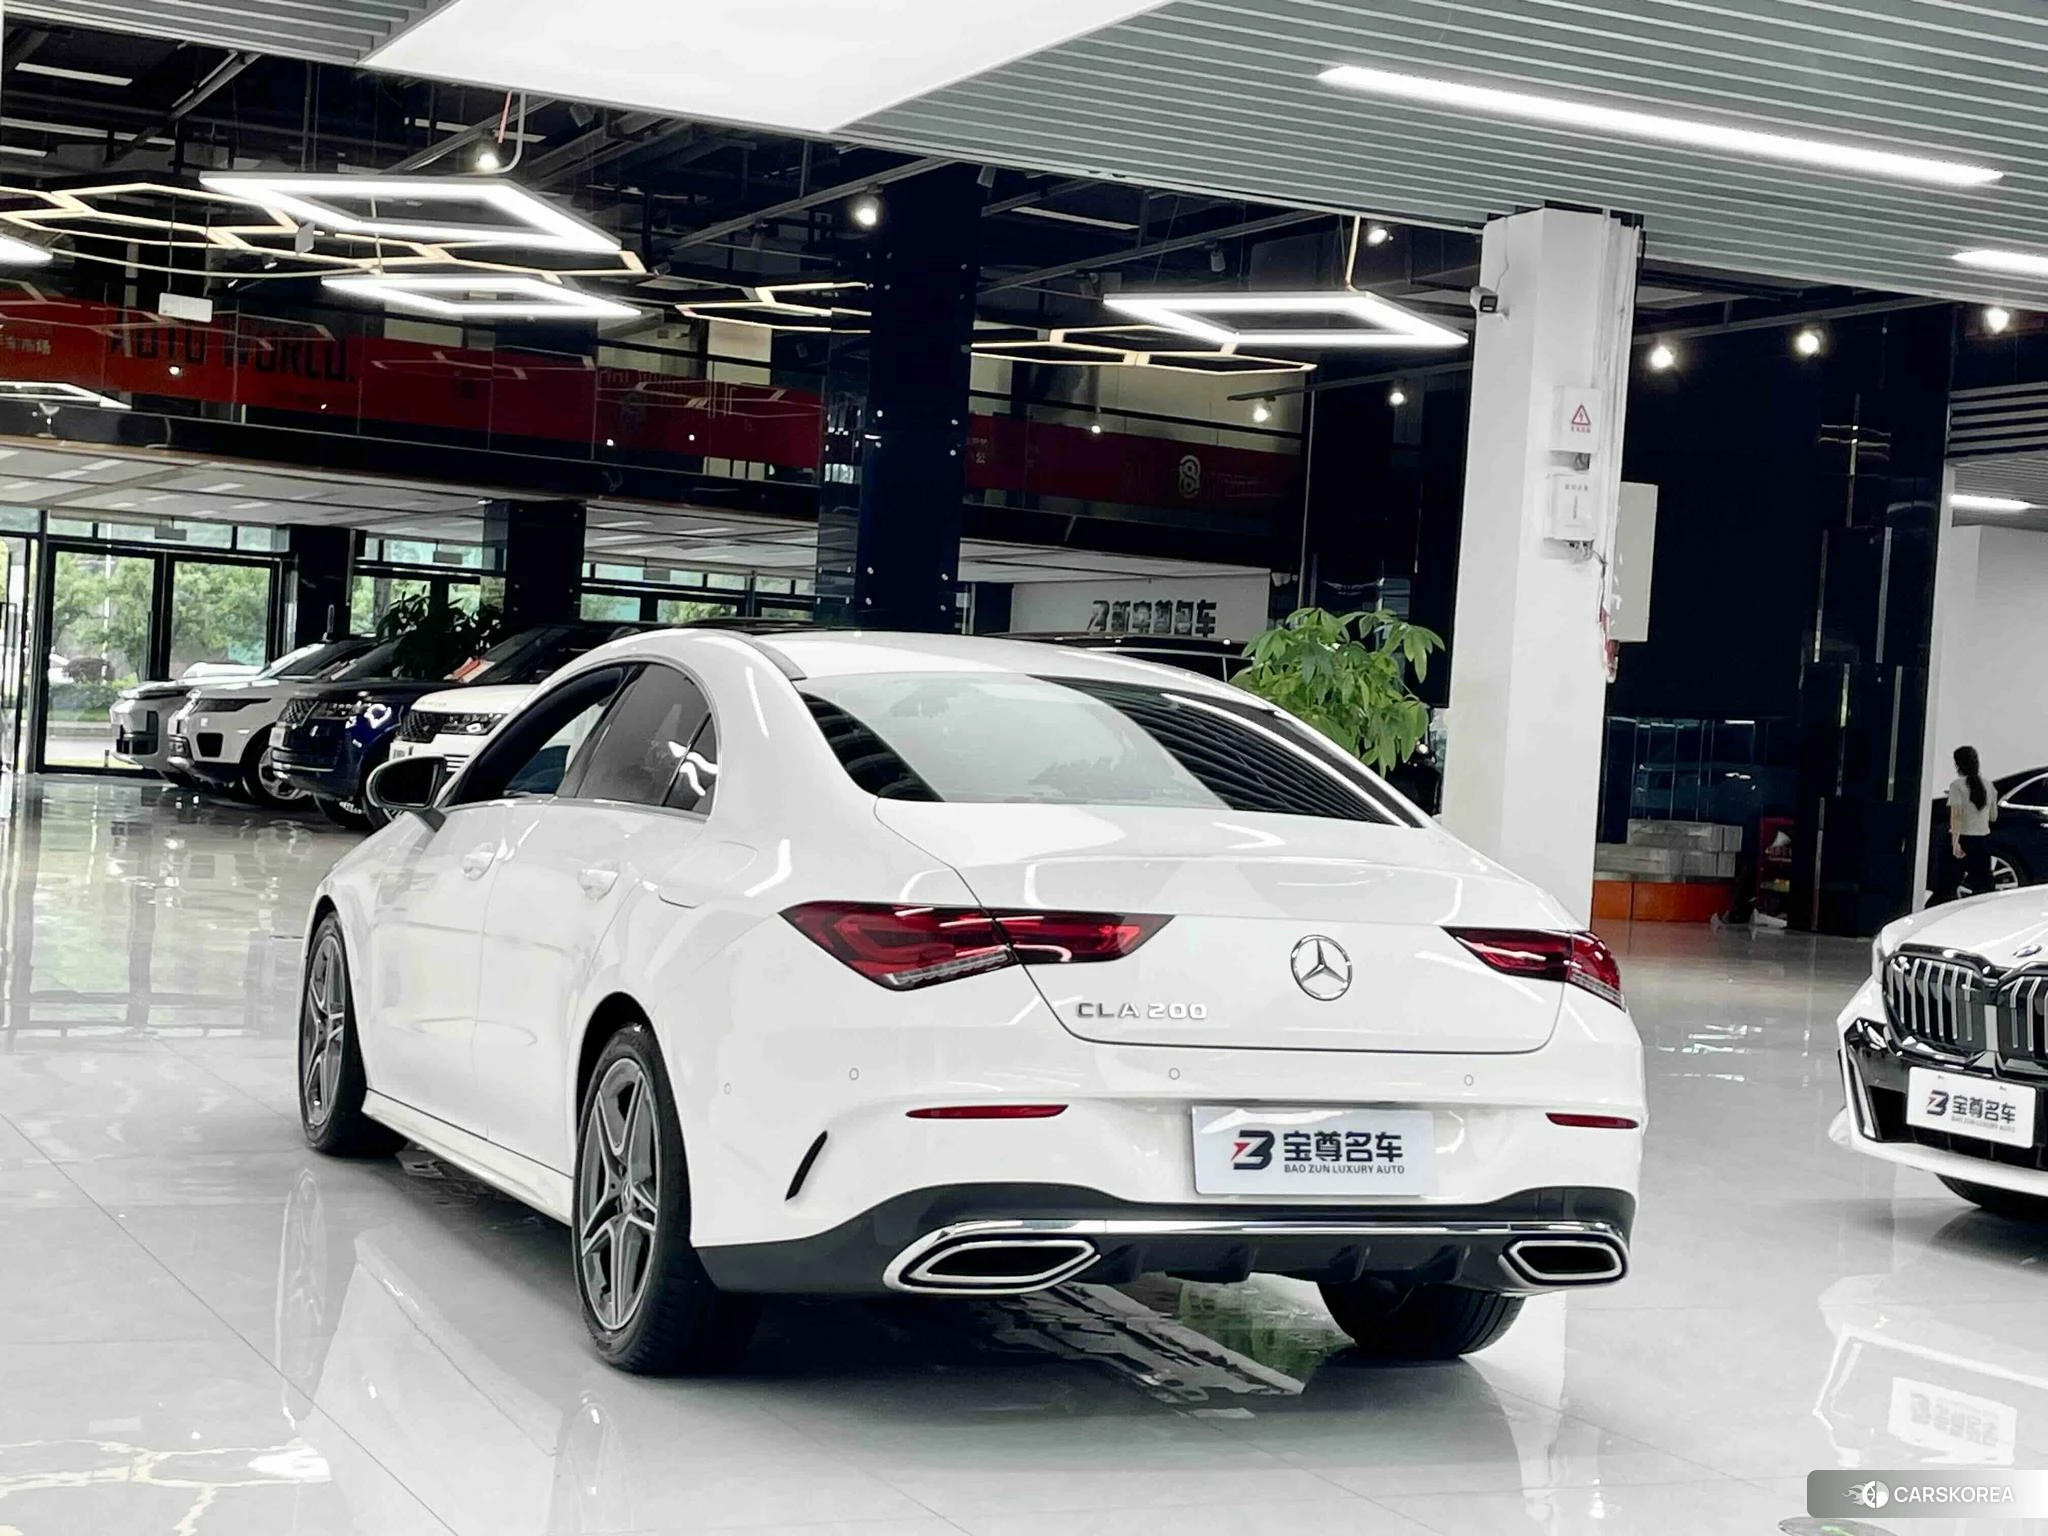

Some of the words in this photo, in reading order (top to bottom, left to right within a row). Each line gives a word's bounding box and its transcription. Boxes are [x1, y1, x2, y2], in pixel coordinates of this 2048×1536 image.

[1077, 1002, 1140, 1018] CLA
[1147, 1002, 1208, 1019] 200
[1952, 1094, 2017, 1125] 宝尊名车
[1283, 1130, 1404, 1162] 宝尊名车
[1284, 1164, 1306, 1174] BAO
[1308, 1164, 1331, 1174] ZUN
[1332, 1165, 1374, 1175] LUXURY
[1376, 1165, 1405, 1175] AUTO
